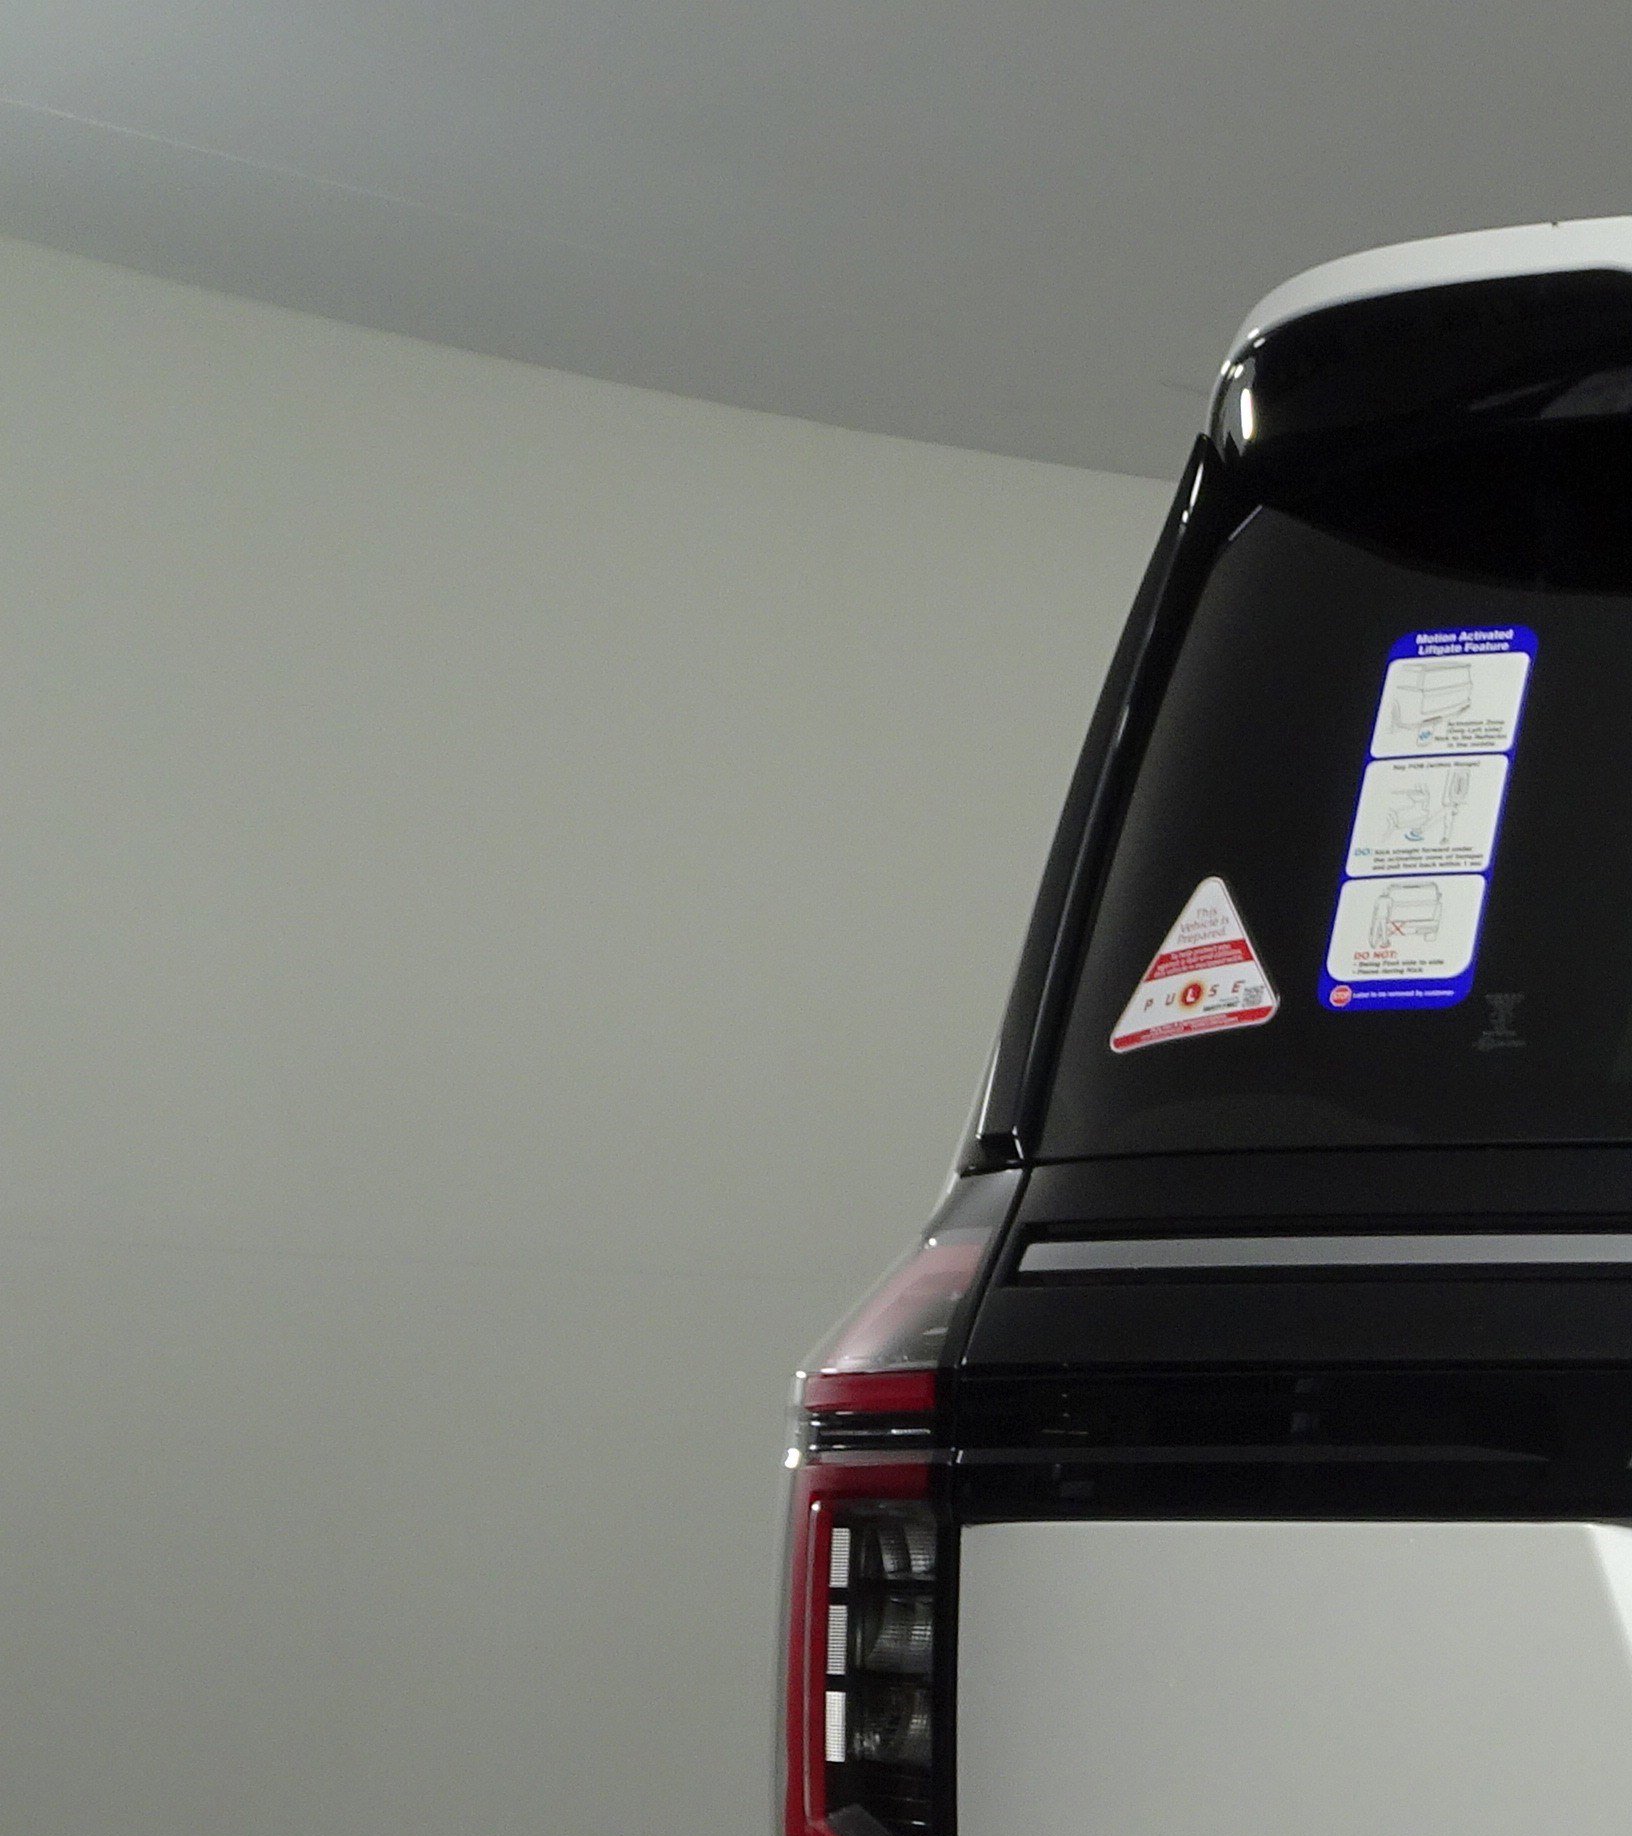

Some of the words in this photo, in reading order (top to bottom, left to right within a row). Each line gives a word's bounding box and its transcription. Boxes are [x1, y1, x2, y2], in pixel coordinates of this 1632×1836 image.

[1416, 634, 1456, 644] Motion
[1458, 629, 1514, 642] Activated
[1418, 644, 1462, 655] Liftgate
[1464, 642, 1510, 653] Feature
[1354, 951, 1369, 960] DO
[1144, 980, 1247, 1012] PULSE
